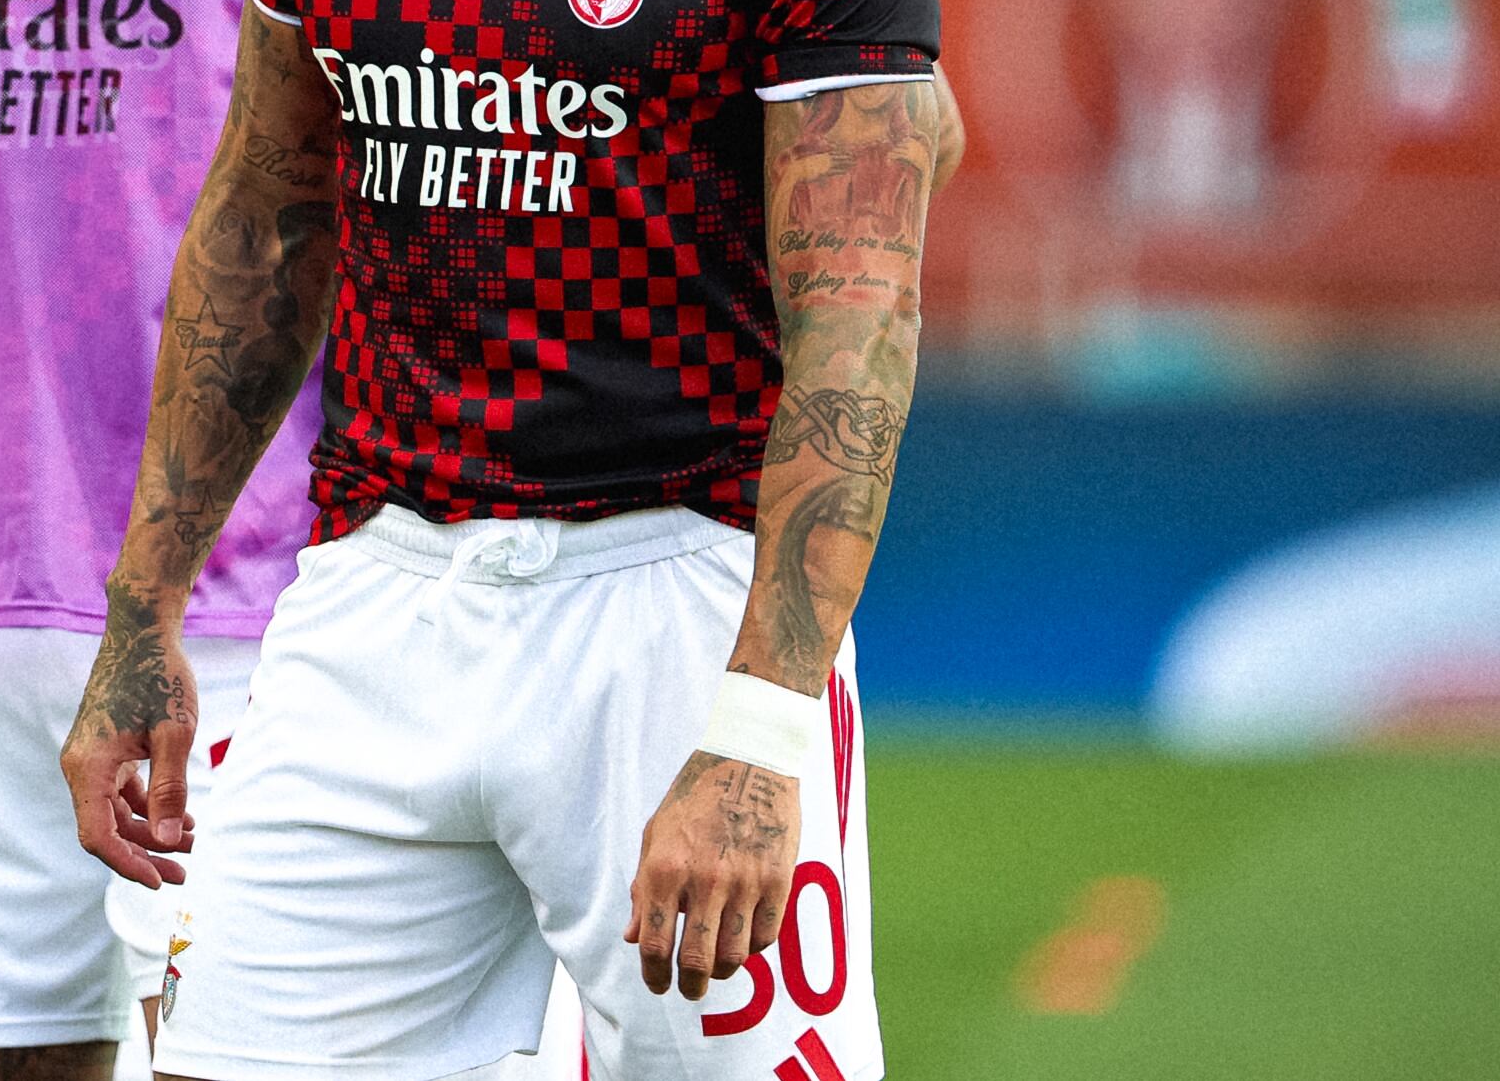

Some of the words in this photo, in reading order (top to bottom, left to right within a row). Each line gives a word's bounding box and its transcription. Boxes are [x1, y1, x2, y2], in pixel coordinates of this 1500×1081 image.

[312, 47, 628, 139] Emirates
[361, 137, 408, 204] FLY
[419, 144, 577, 212] BETTER
